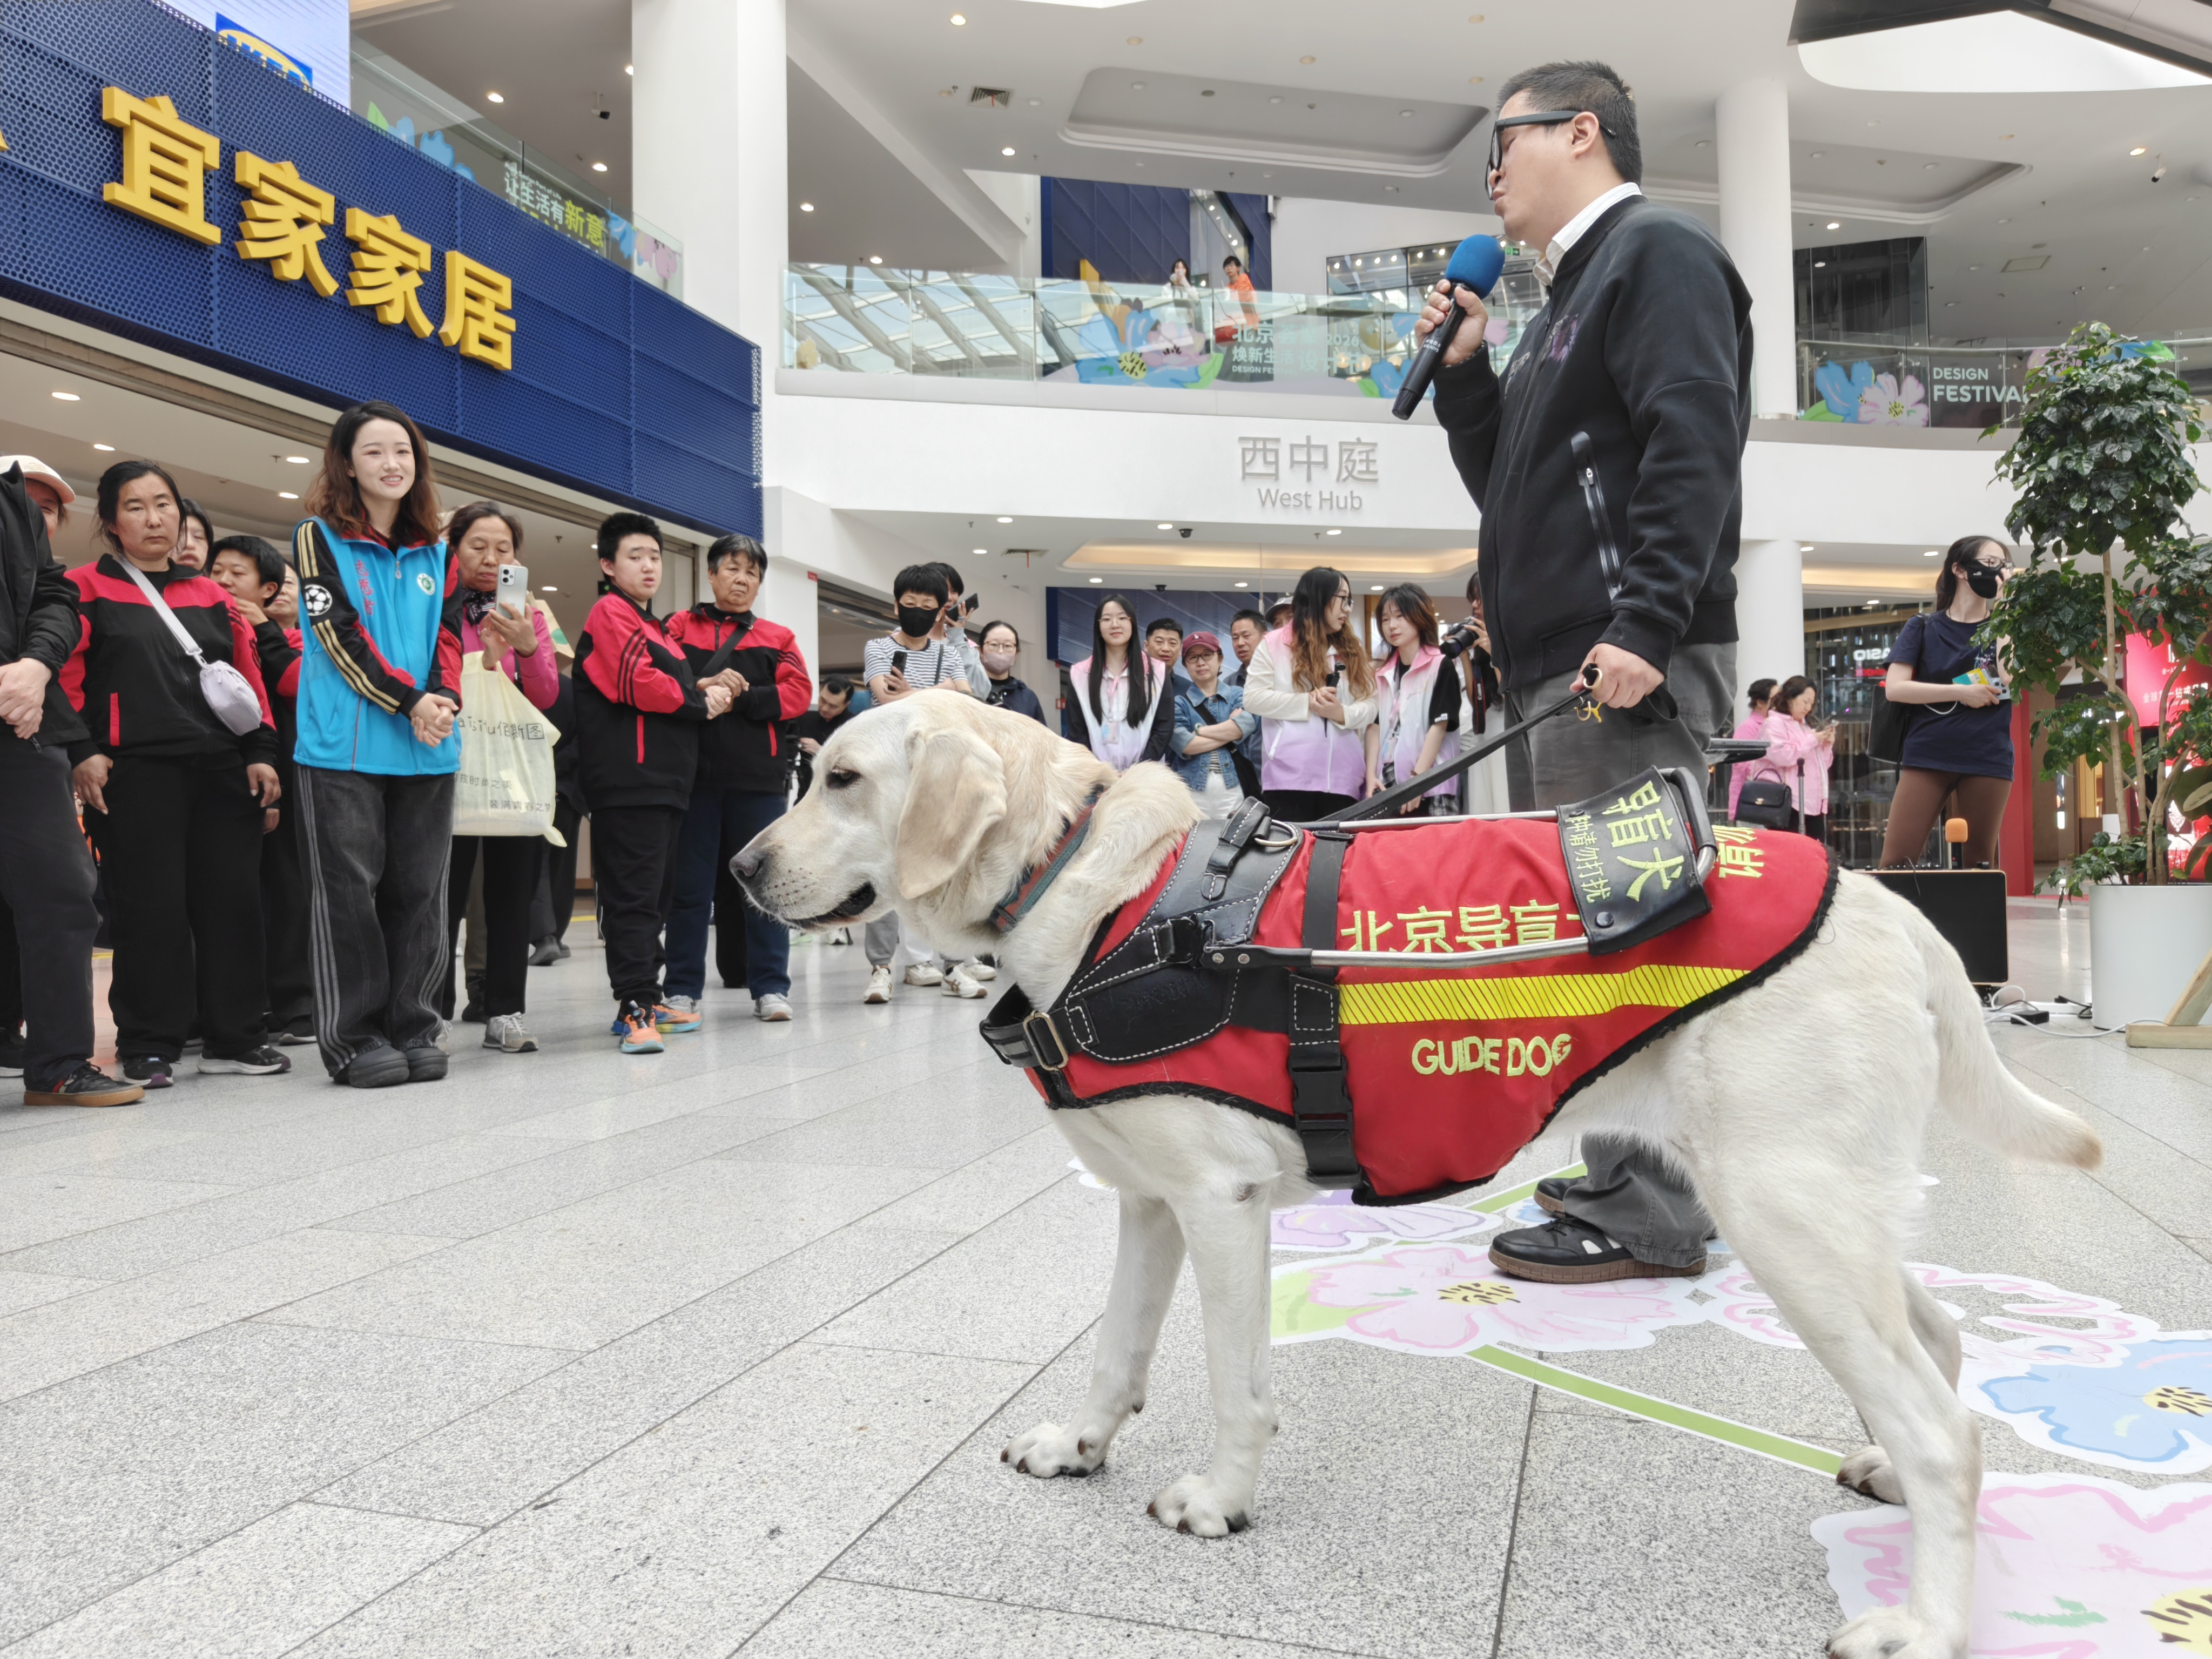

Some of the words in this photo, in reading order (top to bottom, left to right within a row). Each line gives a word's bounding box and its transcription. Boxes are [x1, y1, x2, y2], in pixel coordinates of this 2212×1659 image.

[103, 86, 516, 370] 宜家家居
[1326, 334, 1360, 347] 2026
[1232, 365, 1262, 374] DESIGN
[1933, 367, 1989, 380] DESIGN
[1238, 435, 1378, 483] 西中庭
[1257, 488, 1312, 508] West
[1319, 490, 1363, 510] Hub
[354, 558, 376, 616] 志愿者
[1602, 780, 1685, 902] 导盲犬
[1340, 899, 1583, 953] 北京导盲
[1412, 1036, 1503, 1076] GUIDE
[1507, 1033, 1572, 1077] DOG
